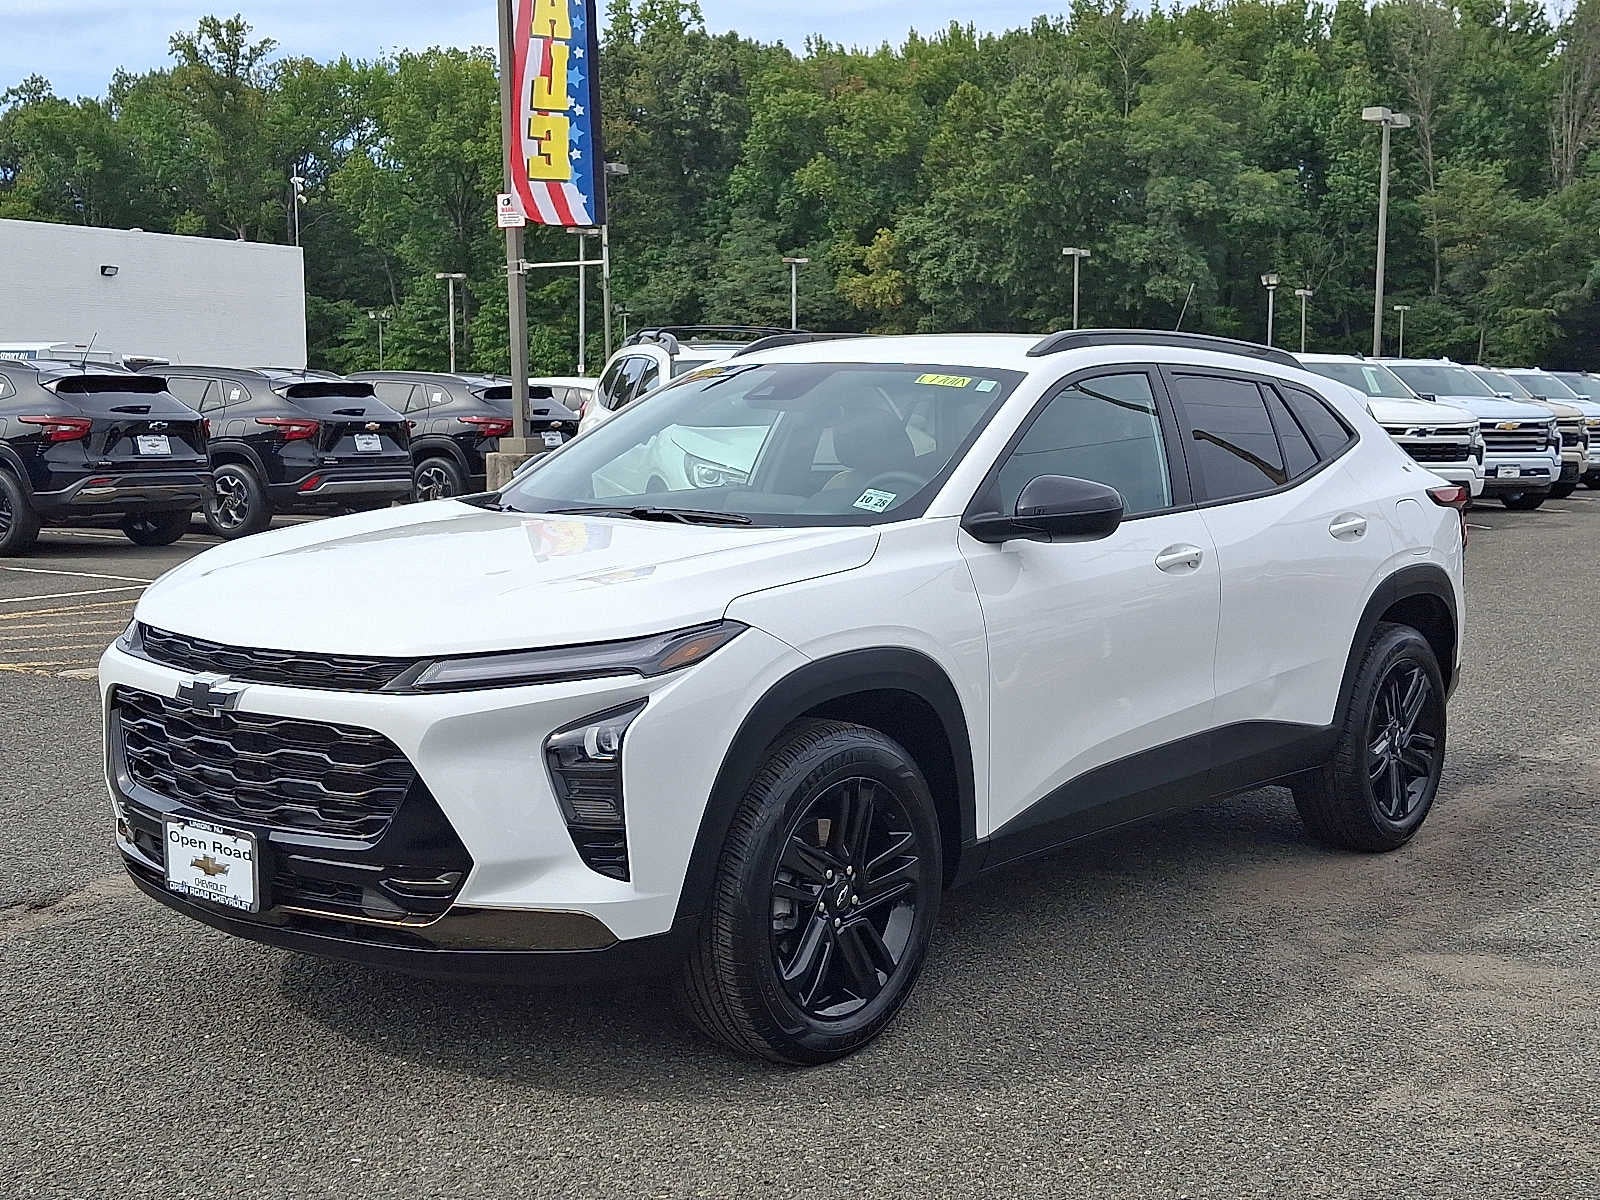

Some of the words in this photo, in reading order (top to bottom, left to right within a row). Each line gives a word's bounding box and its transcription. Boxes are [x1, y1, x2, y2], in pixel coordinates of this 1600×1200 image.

[859, 495, 873, 504] 10
[213, 825, 224, 834] NJ
[169, 830, 207, 850] Open
[212, 841, 253, 861] Road
[194, 877, 227, 895] CHEVROLET
[169, 881, 189, 894] OPEN
[189, 887, 210, 900] ROAD
[210, 893, 251, 911] CHEVROLET
